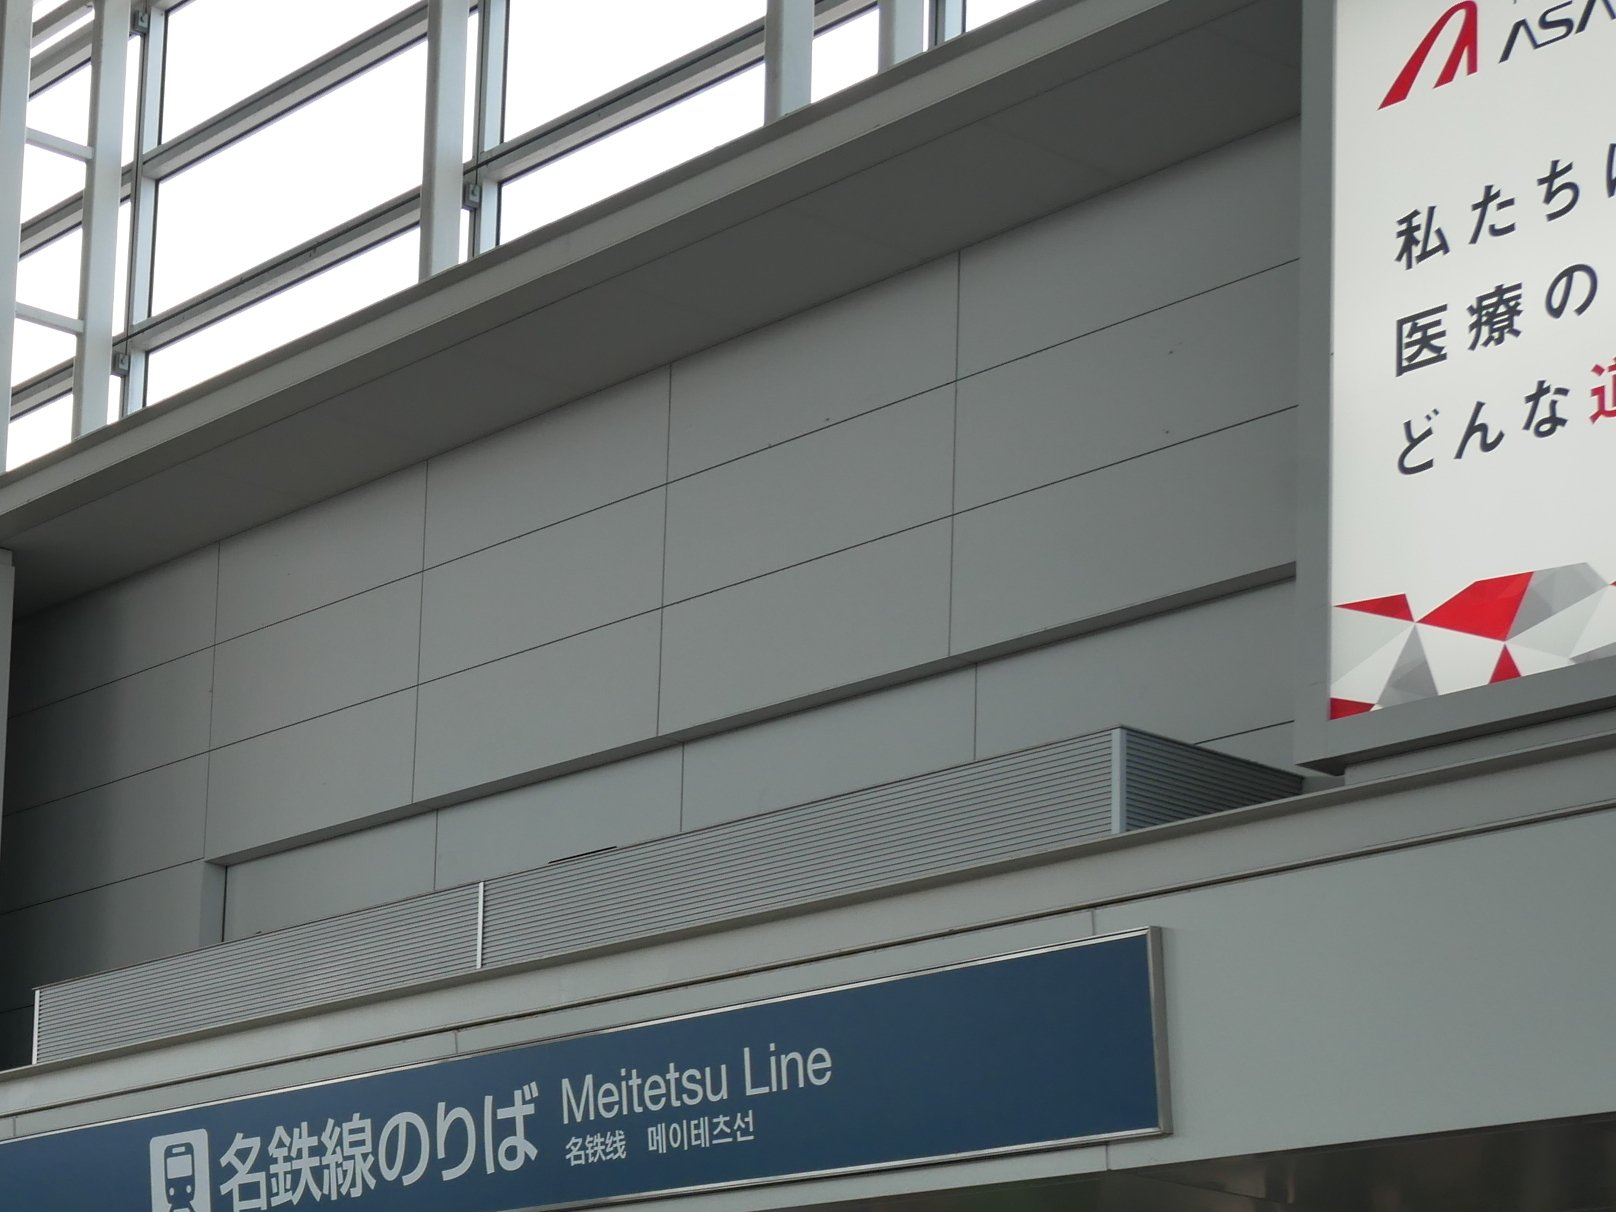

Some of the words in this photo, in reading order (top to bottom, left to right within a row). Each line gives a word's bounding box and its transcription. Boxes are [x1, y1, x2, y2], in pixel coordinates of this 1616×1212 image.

[1395, 263, 1598, 378] 医療の
[561, 1061, 729, 1125] Meitetsu
[743, 1041, 833, 1097] Line
[564, 1133, 627, 1167] 名铁线
[647, 1108, 757, 1156] 메이테츠선
